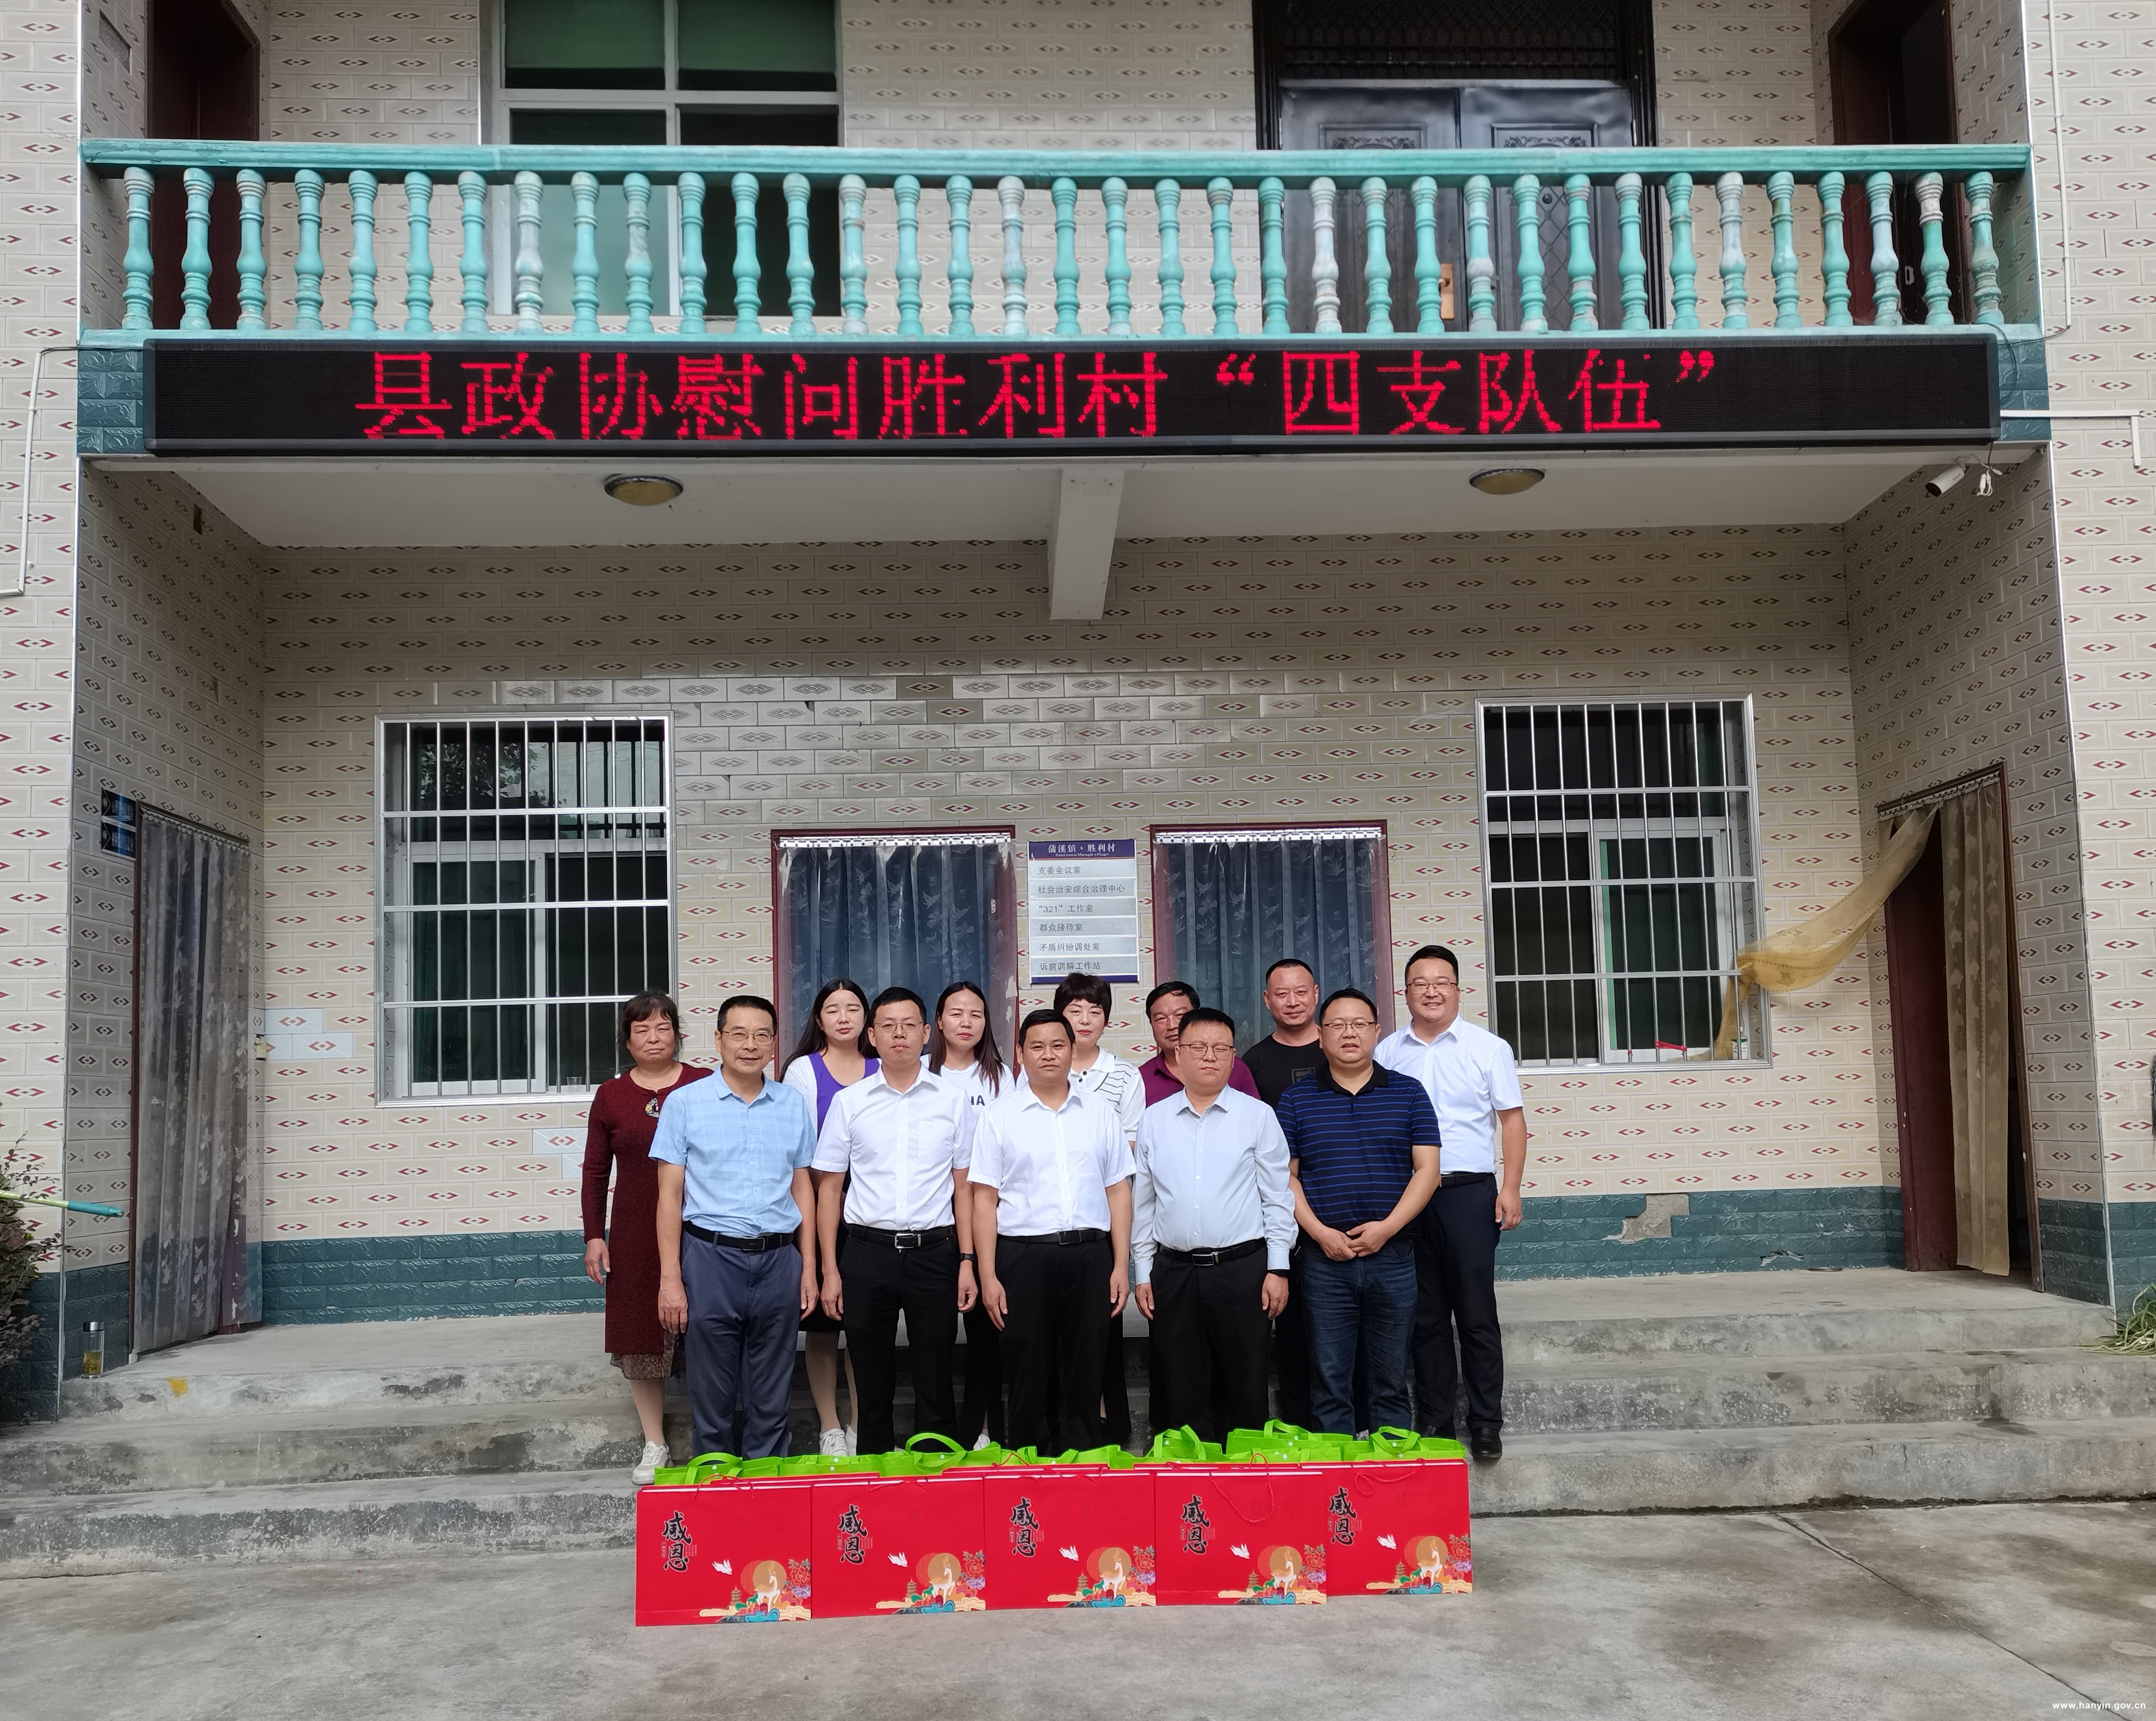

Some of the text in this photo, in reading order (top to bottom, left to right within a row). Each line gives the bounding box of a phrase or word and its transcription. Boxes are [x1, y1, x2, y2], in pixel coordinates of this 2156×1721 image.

[1038, 865, 1081, 875] 支委会议室
[1038, 884, 1125, 894] 社会治安综合治理中心
[1039, 923, 1083, 932] 群众接待室
[1039, 942, 1100, 952] 矛盾纠纷调处室
[1040, 961, 1101, 971] 诉前调解工作站
[1010, 1496, 1039, 1557] 感恩
[1181, 1493, 1210, 1555] 感恩
[1328, 1486, 1356, 1545] 感恩
[661, 1510, 692, 1572] 感恩
[837, 1503, 867, 1564] 感恩
